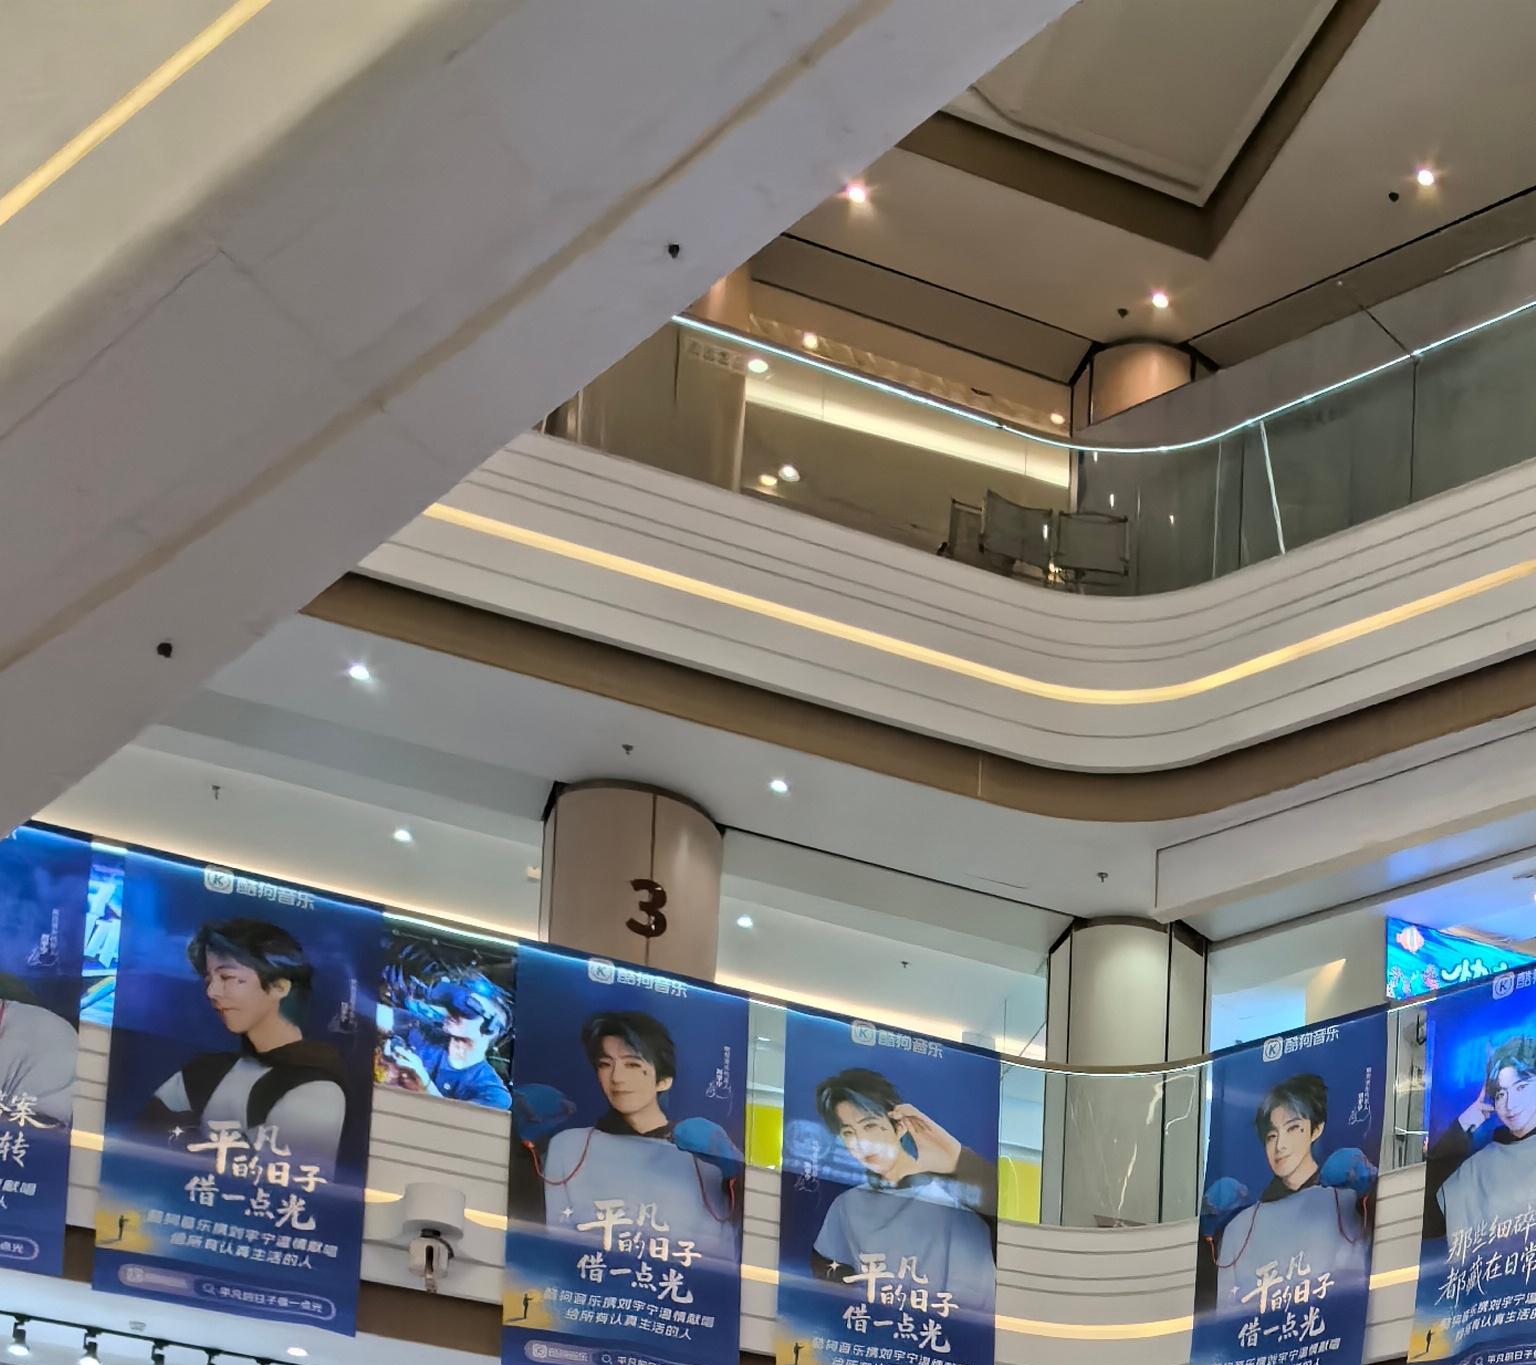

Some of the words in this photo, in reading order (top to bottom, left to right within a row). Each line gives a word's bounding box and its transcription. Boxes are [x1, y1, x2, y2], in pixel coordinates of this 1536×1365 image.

[626, 879, 666, 937] 3
[879, 1030, 943, 1059] 酷狗音乐
[1284, 1026, 1339, 1054] 酷狗音乐
[188, 1121, 290, 1178] 平凡
[232, 1154, 327, 1190] 的日子
[185, 1176, 316, 1230] 借一点光
[577, 1202, 669, 1253] 平凡
[618, 1230, 702, 1267] 的日子
[577, 1254, 694, 1303] 借一点光
[843, 1253, 928, 1305] 平凡
[880, 1283, 958, 1318] 的日子
[1248, 1252, 1311, 1313] 平凡
[1271, 1277, 1334, 1313] 的日子
[565, 1309, 693, 1340] 给所有认真生活的人
[843, 1305, 952, 1354] 借一点光
[1238, 1313, 1325, 1355] 借一点光
